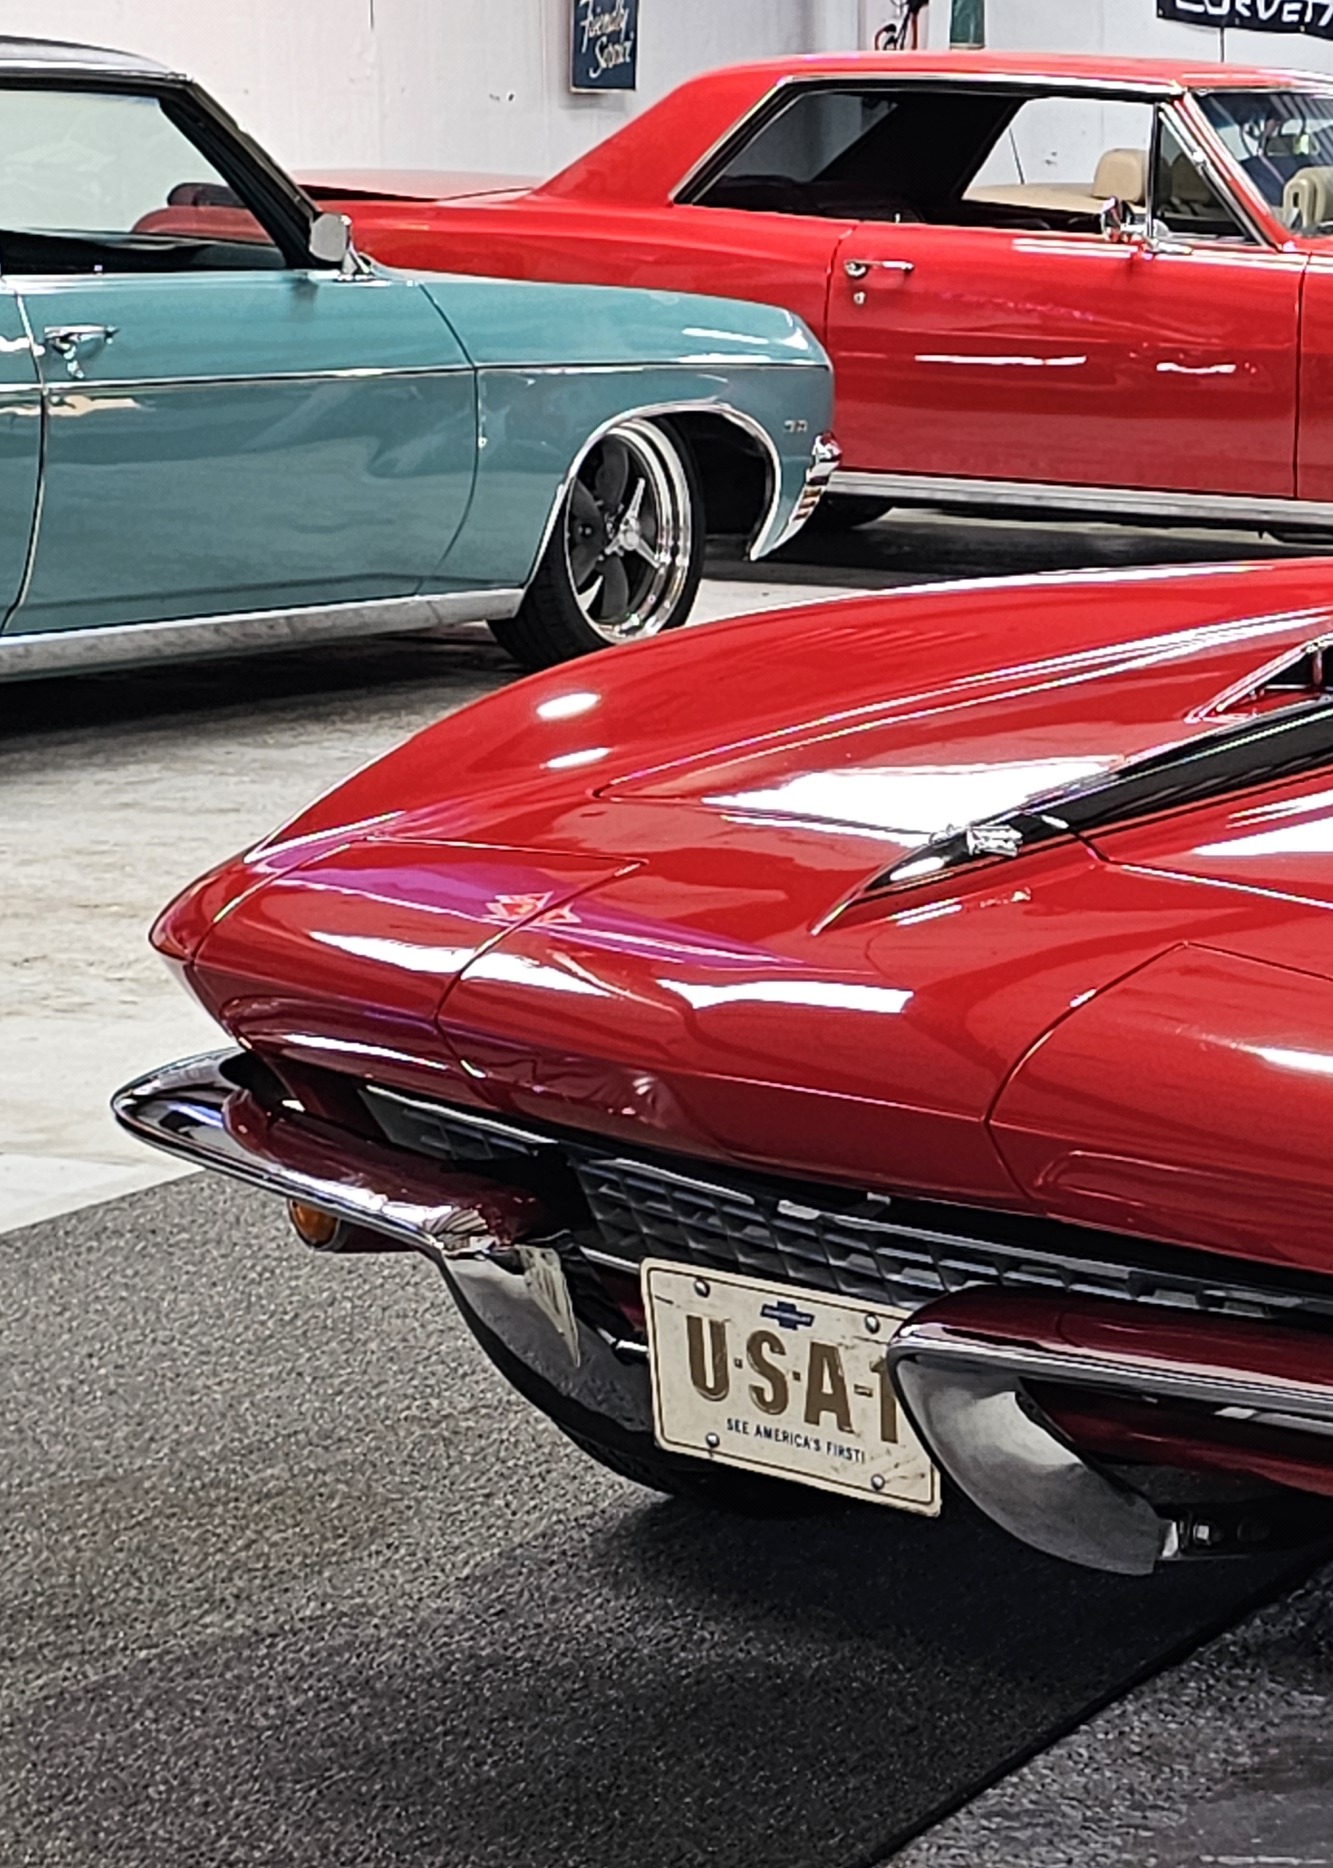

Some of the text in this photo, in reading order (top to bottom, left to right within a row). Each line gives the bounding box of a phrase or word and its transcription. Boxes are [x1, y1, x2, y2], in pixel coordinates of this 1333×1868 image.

[727, 1418, 866, 1464] SEE AMERICA'S FIRST!
